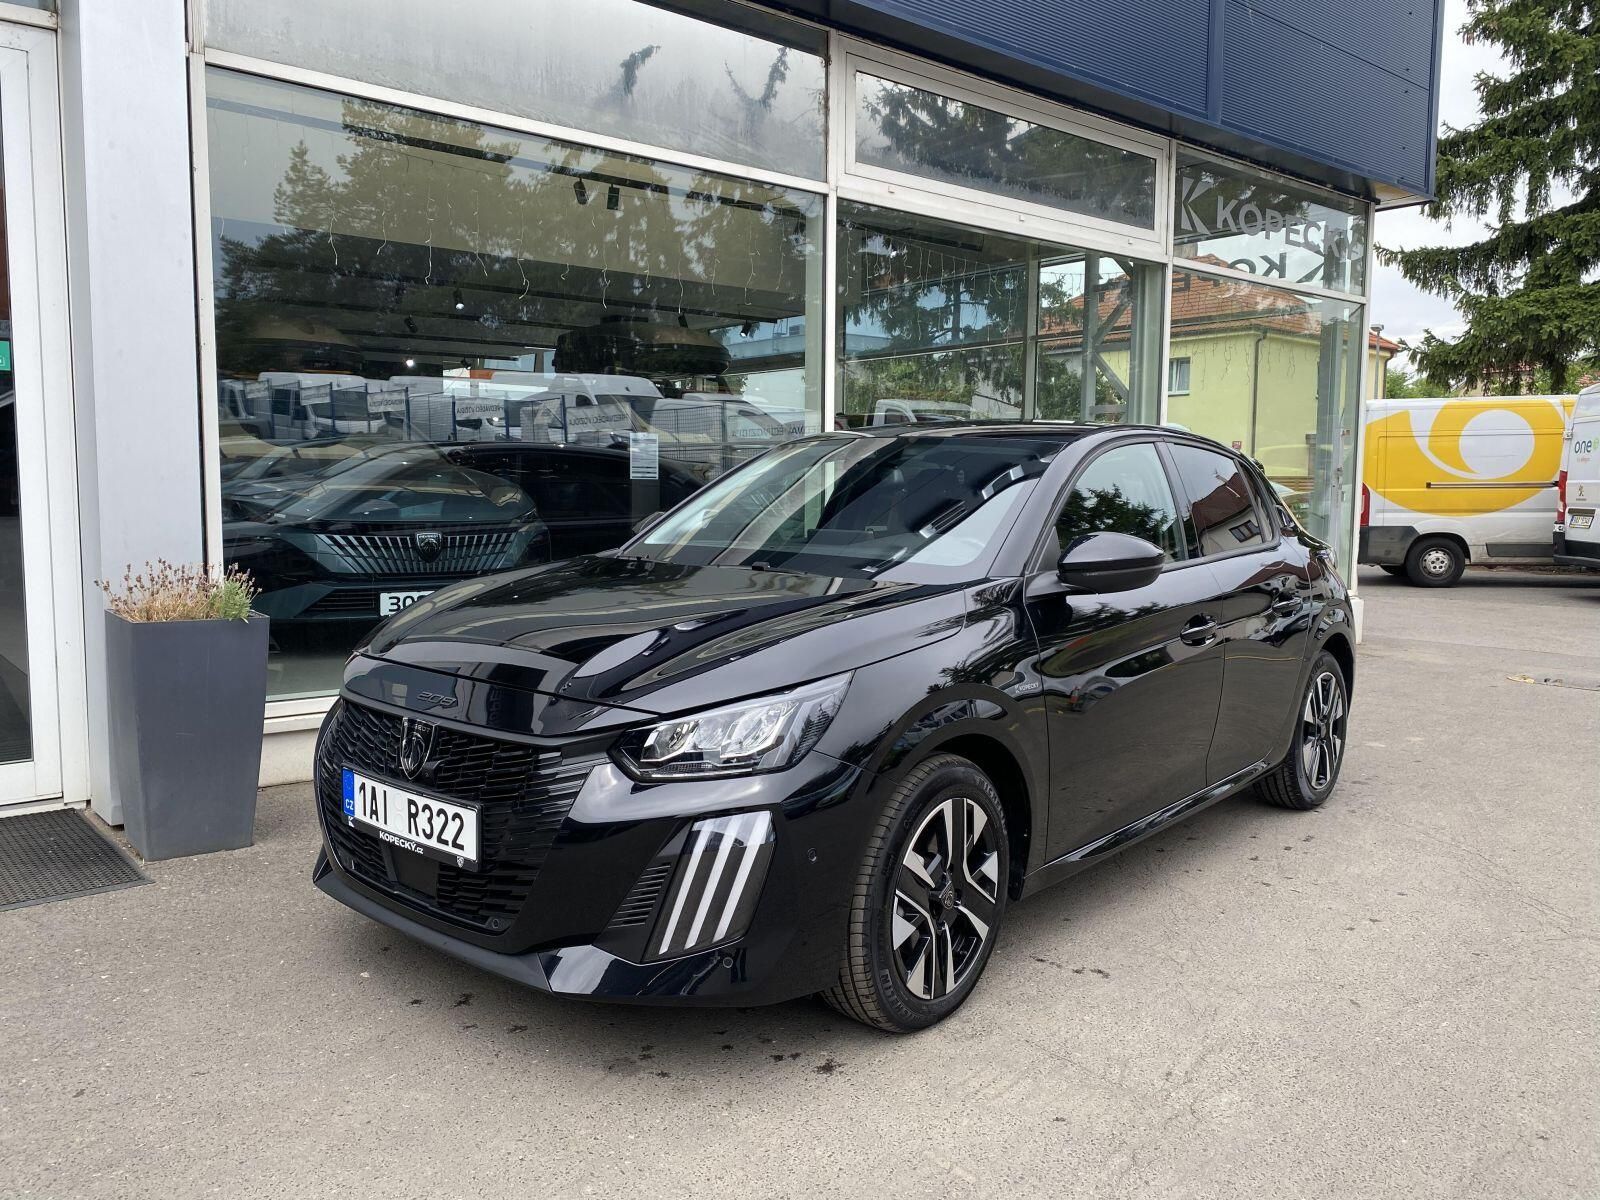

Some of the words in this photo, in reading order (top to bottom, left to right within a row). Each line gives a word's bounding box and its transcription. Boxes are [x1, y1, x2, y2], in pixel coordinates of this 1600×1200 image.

[388, 595, 426, 612] 30
[345, 798, 354, 811] CZ
[358, 781, 388, 826] 1AI
[407, 798, 465, 852] R322
[379, 830, 424, 855] KOPECKÝ.cz
